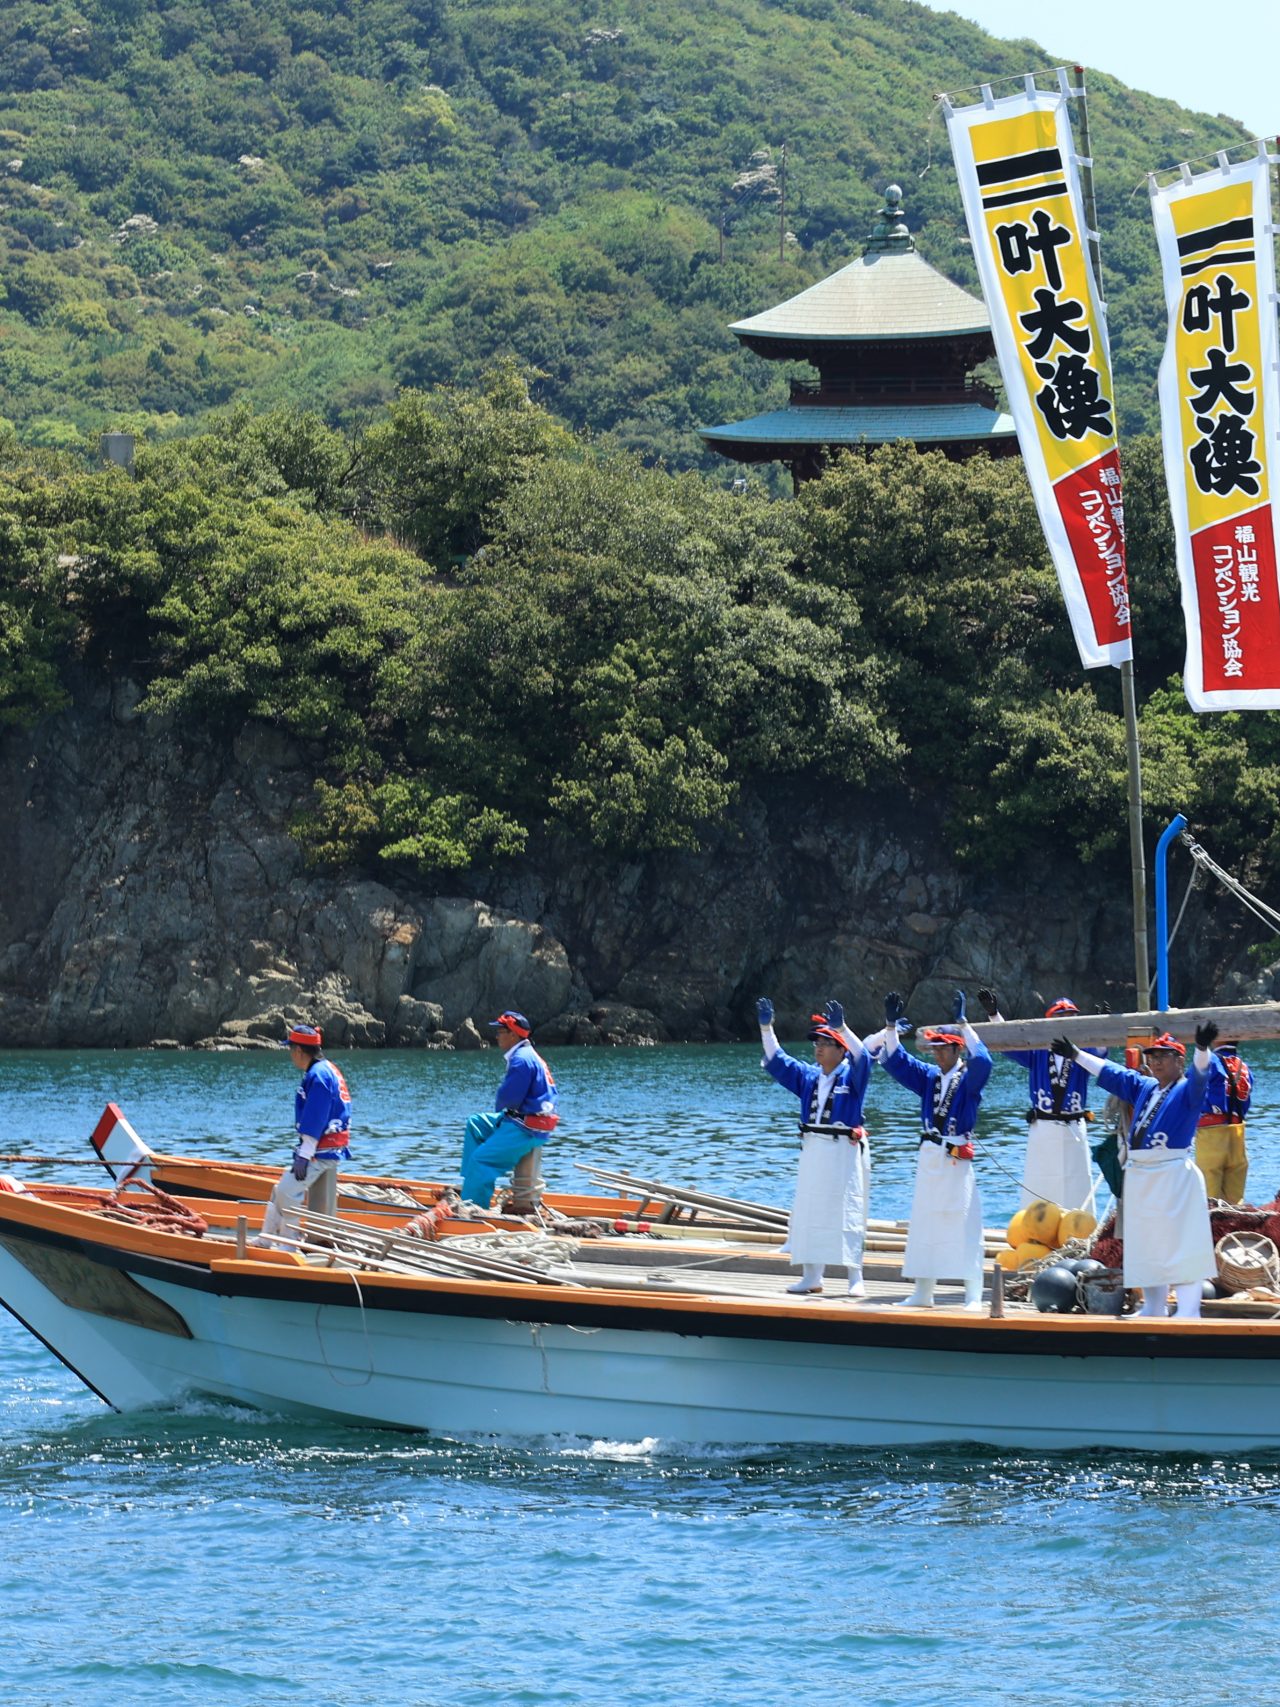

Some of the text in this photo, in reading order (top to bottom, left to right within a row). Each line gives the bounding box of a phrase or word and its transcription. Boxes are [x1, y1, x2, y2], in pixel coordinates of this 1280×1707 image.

[996, 210, 1113, 440] 叶大漁
[1183, 274, 1262, 496] 叶大漁
[1212, 545, 1244, 677] コンベンション協会
[1234, 525, 1261, 602] 福山観光
